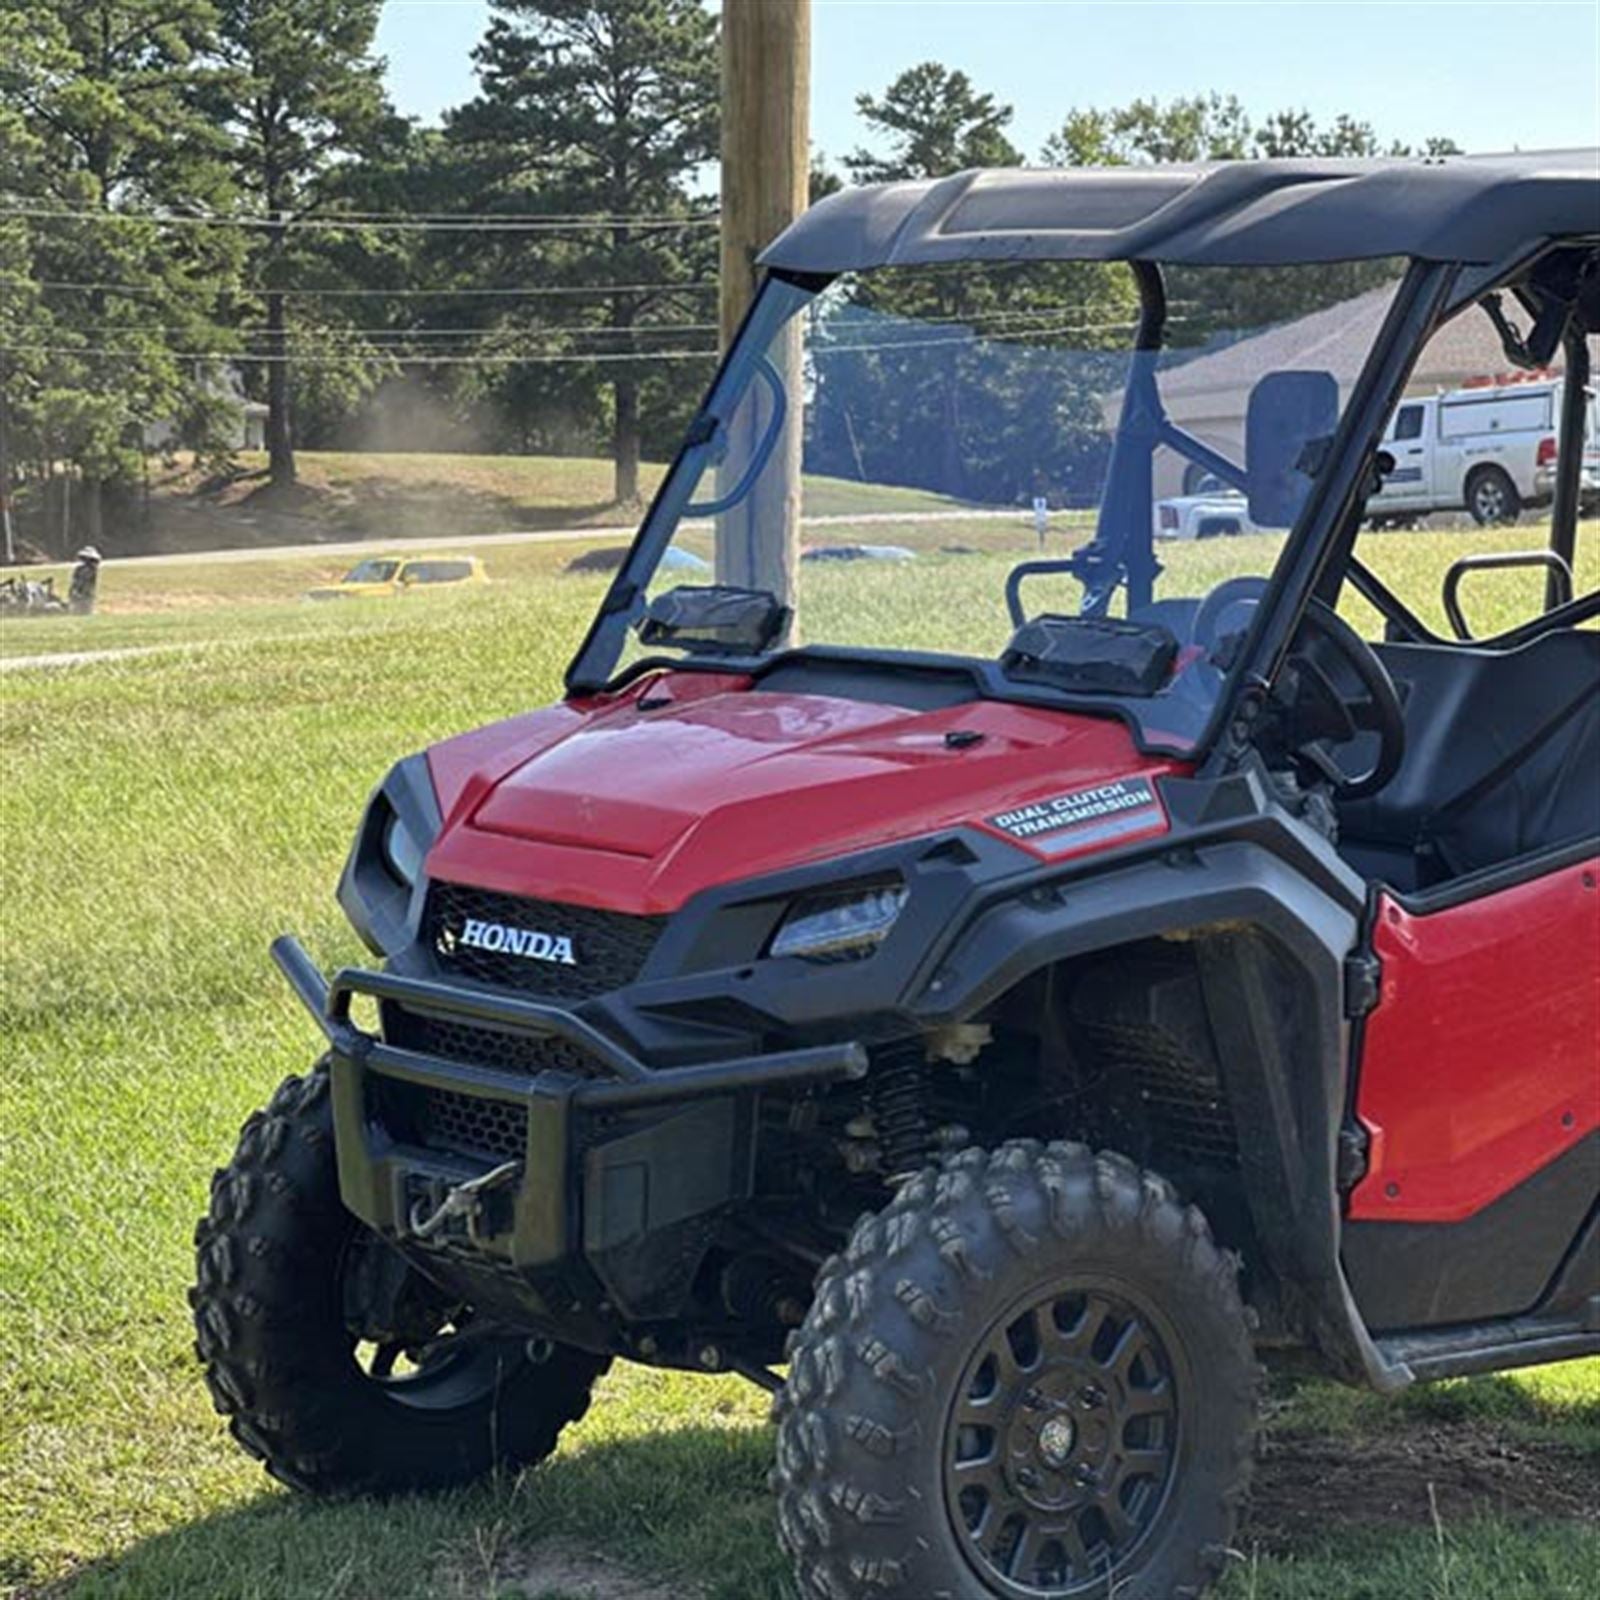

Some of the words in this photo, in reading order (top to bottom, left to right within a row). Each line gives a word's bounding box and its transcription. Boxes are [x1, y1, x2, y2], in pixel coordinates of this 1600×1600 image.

[995, 803, 1049, 828] DUAL
[1052, 783, 1126, 810] CLUTCH
[1009, 790, 1152, 836] TRANSMISSION
[460, 919, 576, 964] HONDA
